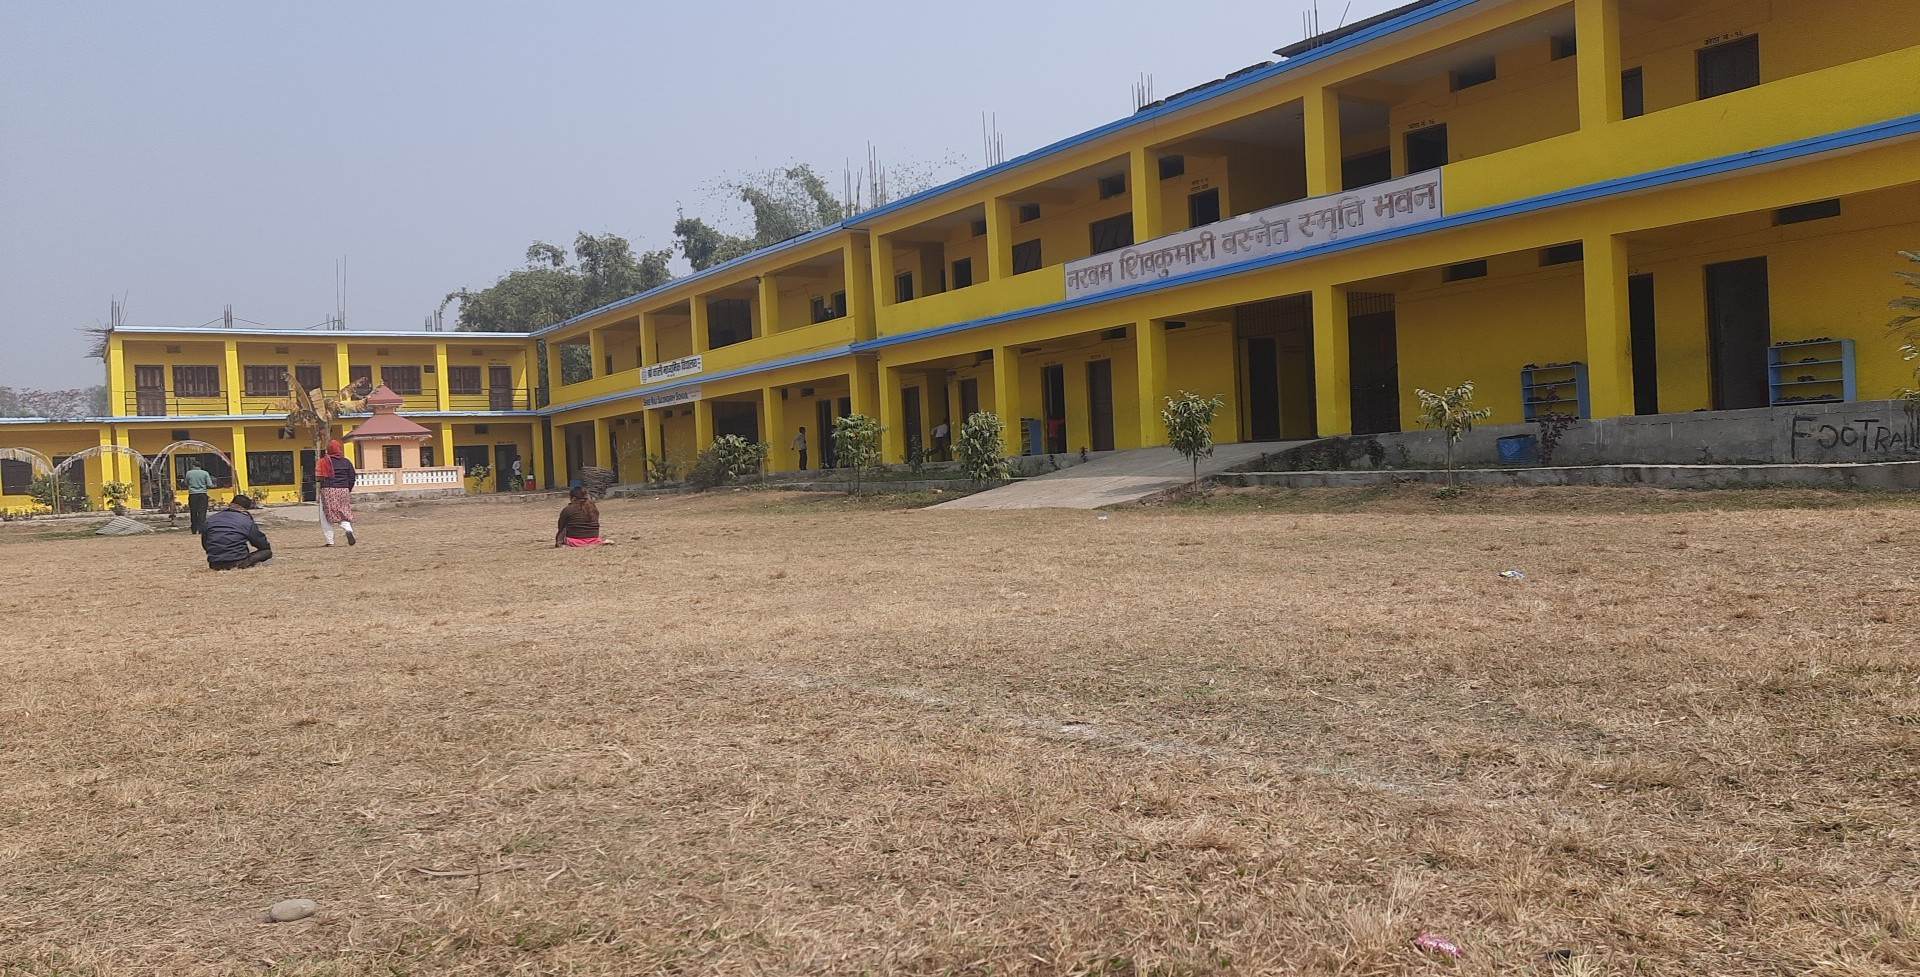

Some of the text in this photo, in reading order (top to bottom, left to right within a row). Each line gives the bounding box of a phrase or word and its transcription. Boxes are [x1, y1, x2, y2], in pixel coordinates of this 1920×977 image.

[1118, 230, 1217, 280] शिवकुमारी
[1297, 195, 1367, 241] स्मृति
[1372, 181, 1438, 219] भवन
